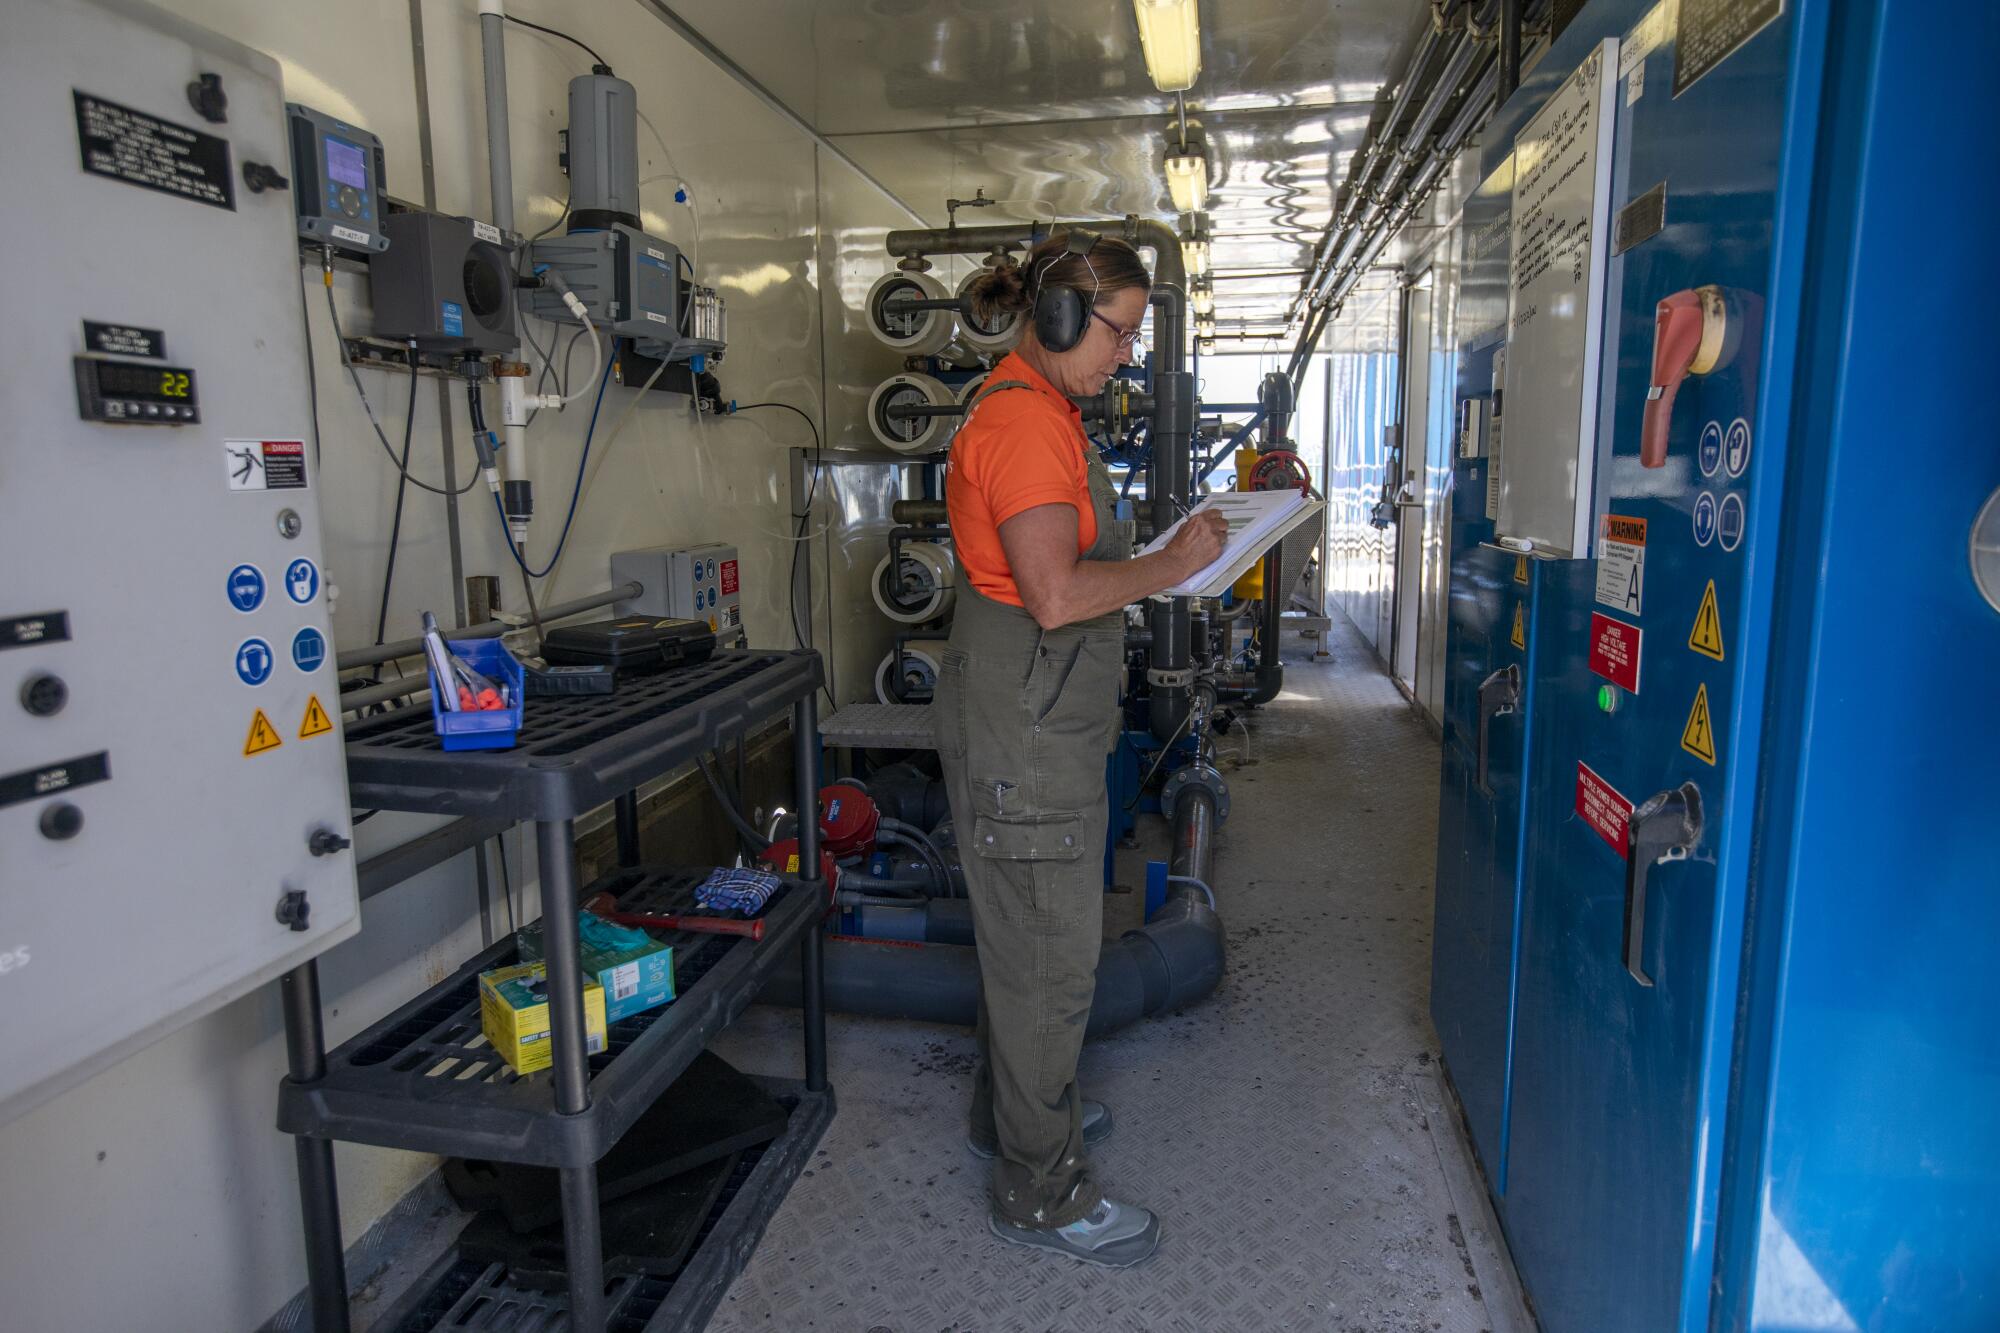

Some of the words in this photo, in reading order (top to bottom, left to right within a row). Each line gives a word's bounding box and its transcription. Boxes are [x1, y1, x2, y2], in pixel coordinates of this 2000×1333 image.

[272, 444, 303, 452] DANGER
[1611, 519, 1645, 542] WARNING
[1625, 564, 1640, 612] A
[1580, 772, 1596, 794] MULTIPLE
[1597, 786, 1610, 803] POWER
[1610, 799, 1629, 823] SOURCES
[1584, 788, 1605, 814] DISCONNECT
[1606, 809, 1622, 831] SOURCE
[1584, 802, 1598, 822] BEFORE
[1600, 817, 1619, 842] SERVICING
